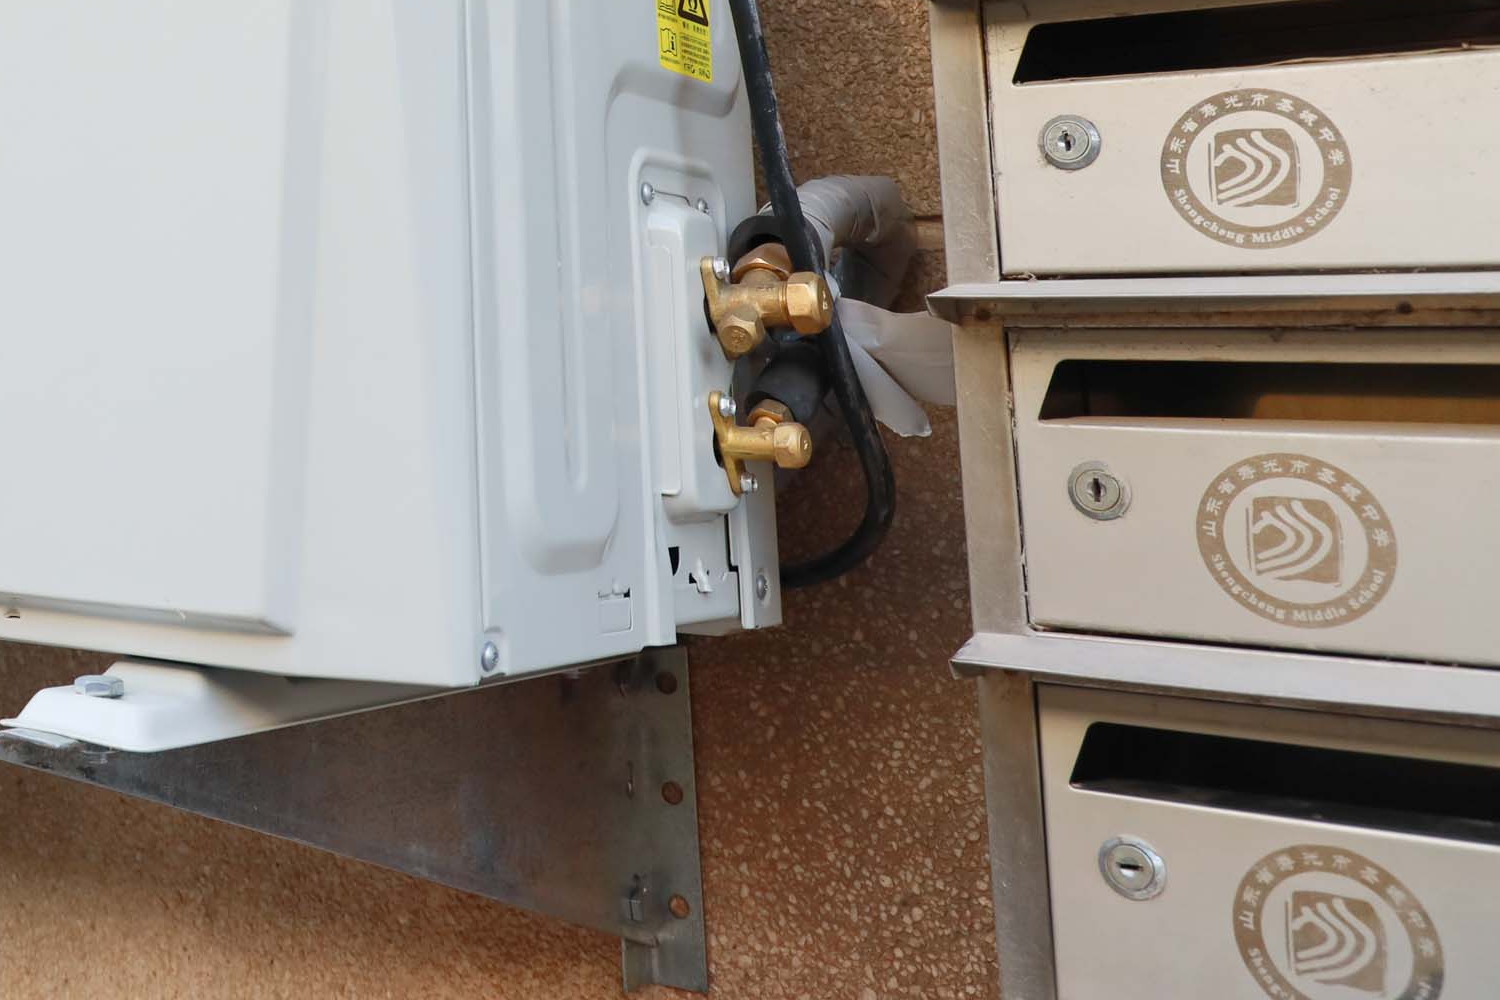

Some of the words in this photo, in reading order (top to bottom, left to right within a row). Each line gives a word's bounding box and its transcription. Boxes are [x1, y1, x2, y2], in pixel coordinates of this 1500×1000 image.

[1173, 187, 1245, 244] Shengcheng
[1251, 225, 1305, 244] Middle
[1305, 186, 1342, 228] School
[1211, 552, 1286, 621] Shengcheng
[1292, 606, 1348, 623] Middle
[1348, 568, 1387, 611] School
